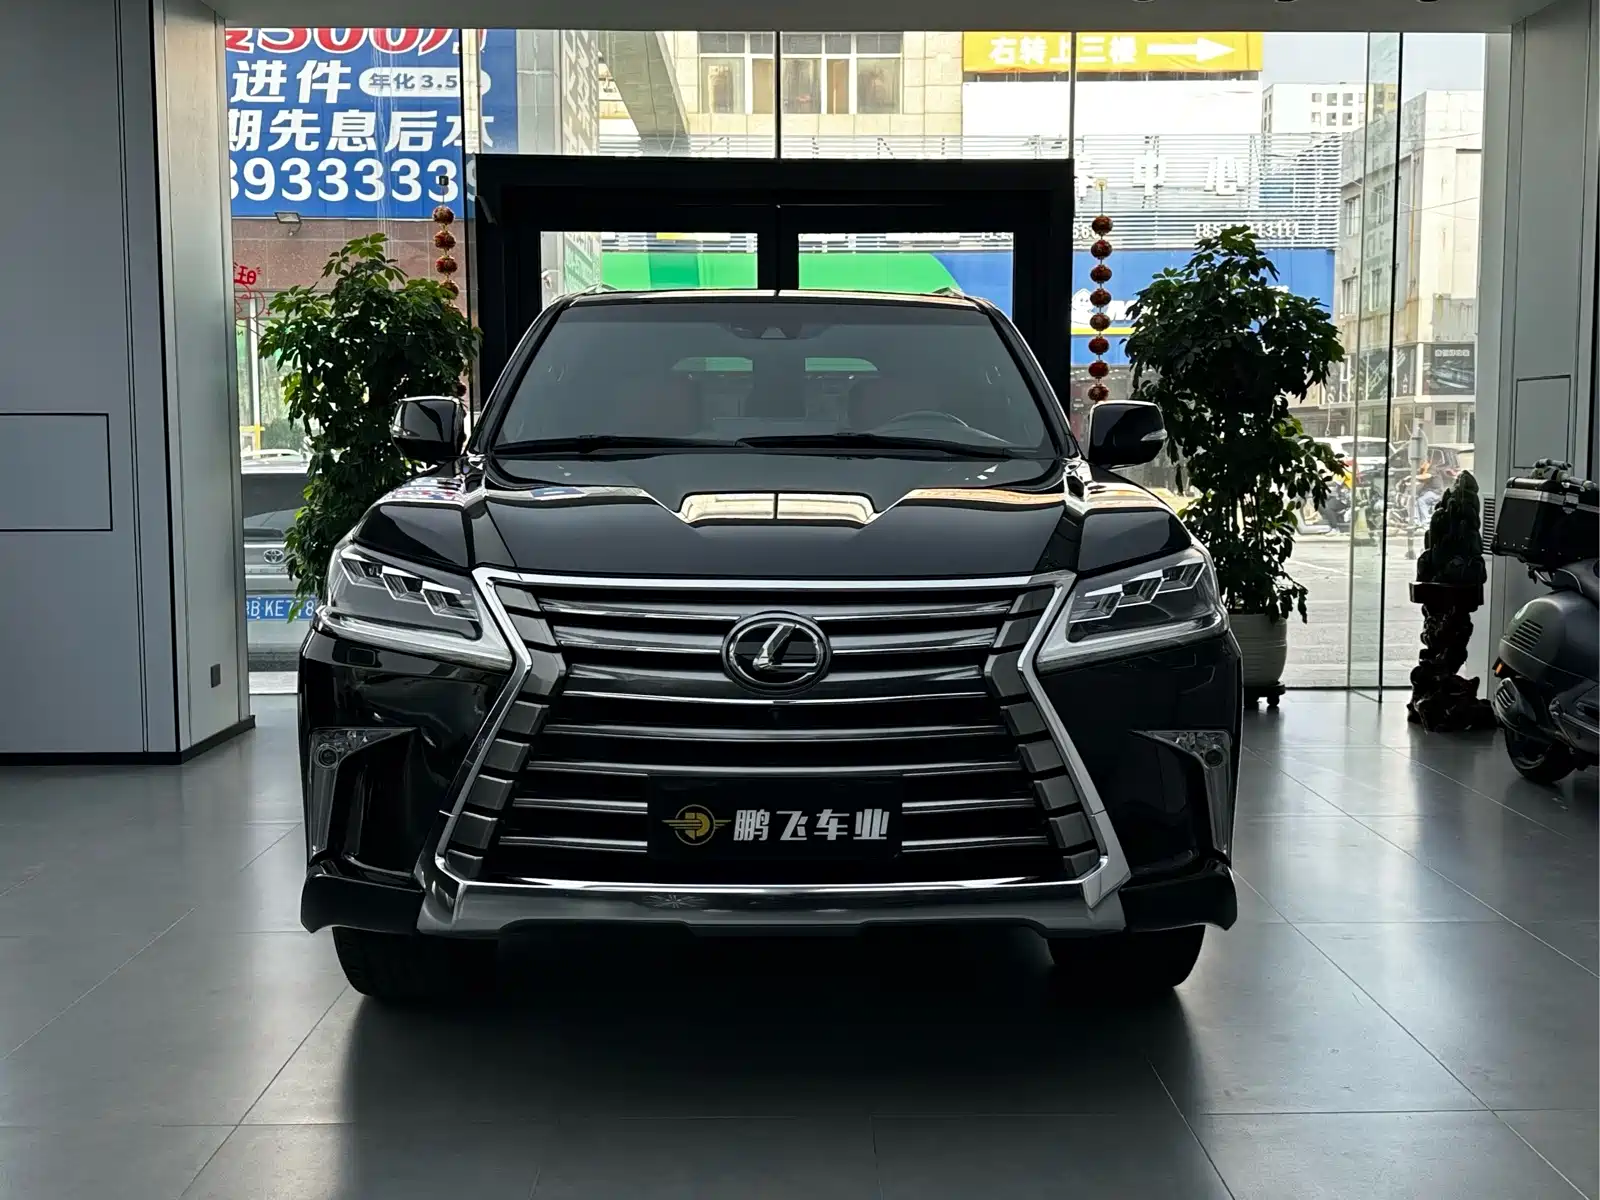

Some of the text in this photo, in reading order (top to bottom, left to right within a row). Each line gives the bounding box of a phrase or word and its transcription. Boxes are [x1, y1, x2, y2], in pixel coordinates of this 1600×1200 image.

[230, 60, 351, 104] 进件
[230, 157, 476, 202] 933333
[733, 808, 890, 841] 鹏飞车业
